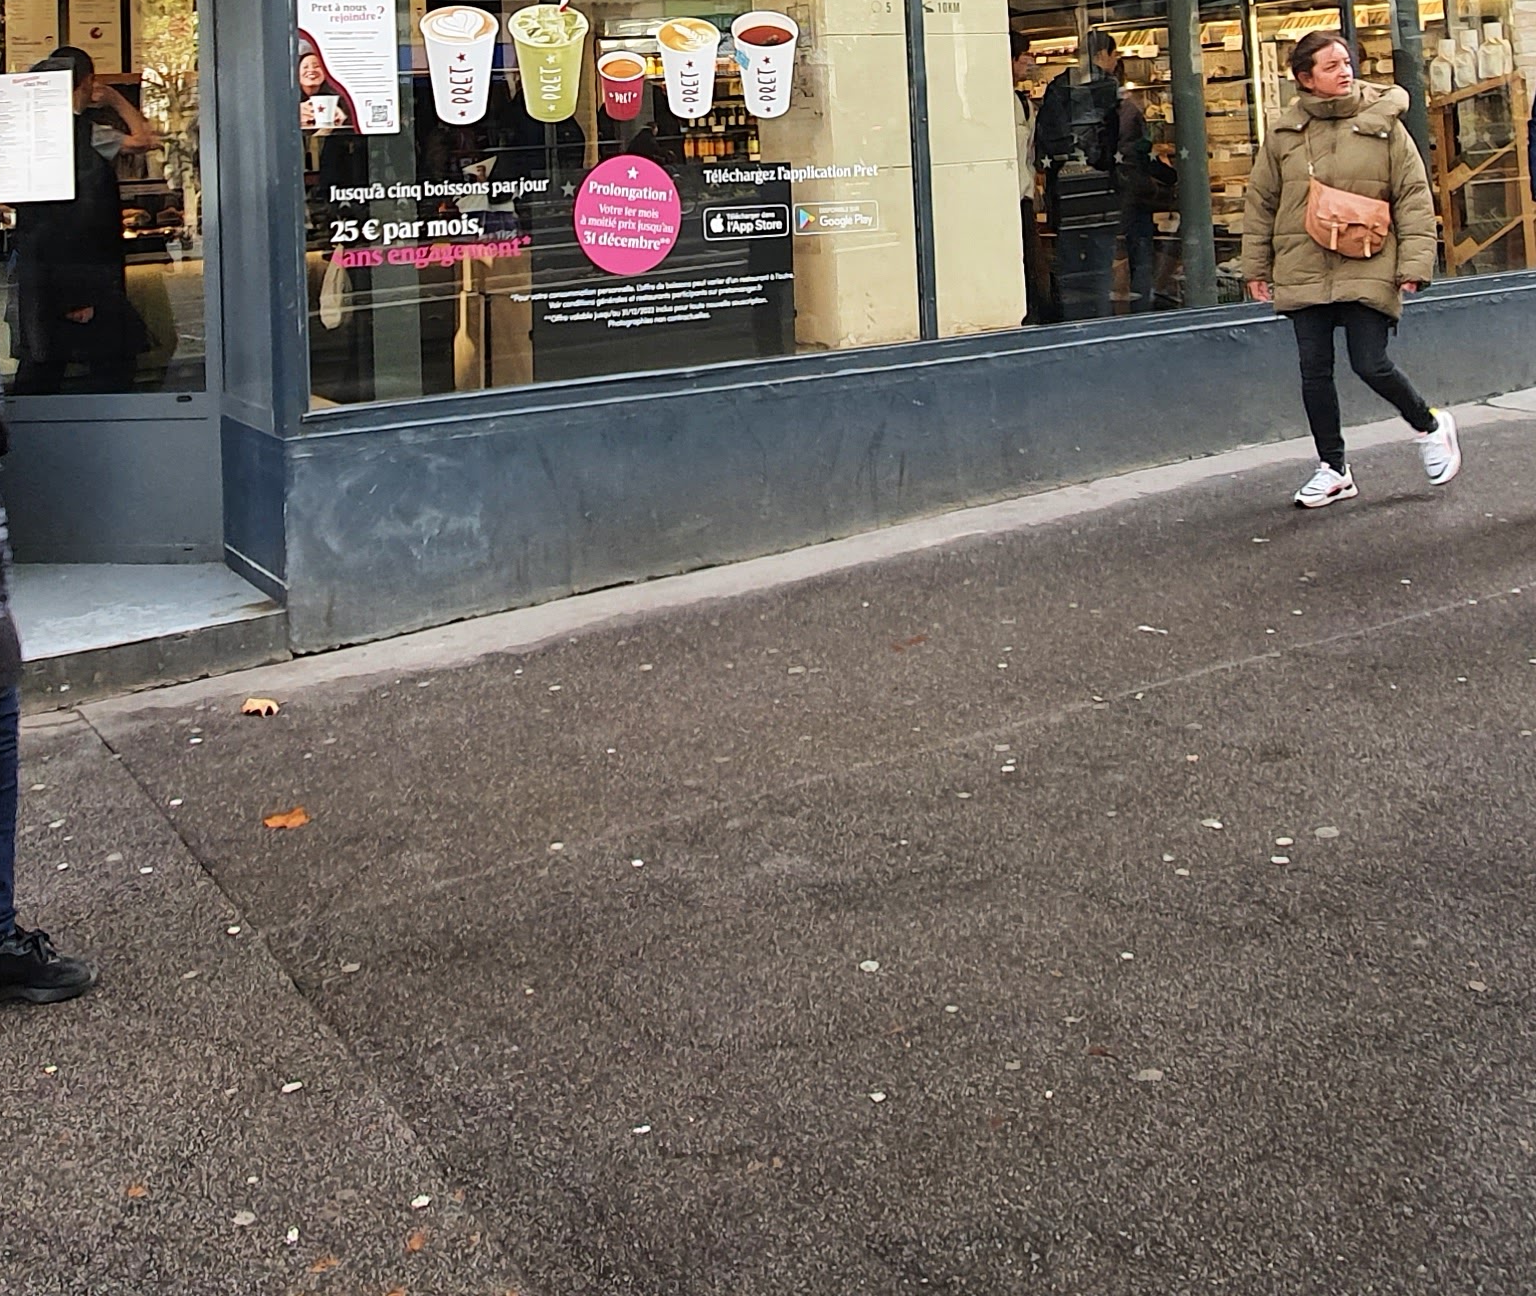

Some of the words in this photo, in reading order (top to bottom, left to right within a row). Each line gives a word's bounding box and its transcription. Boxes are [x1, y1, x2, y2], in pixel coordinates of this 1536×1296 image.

[450, 67, 474, 105] PRET
[540, 67, 560, 101] PRET
[682, 70, 700, 103] PRET
[759, 67, 777, 103] PRET
[703, 169, 776, 185] Téléchargez
[777, 165, 851, 183] l'application
[853, 164, 879, 177] Pret
[387, 181, 421, 201] cinq
[424, 179, 490, 197] boissons
[492, 180, 518, 198] par
[517, 176, 550, 196] jour
[588, 180, 667, 202] Prolongation
[598, 203, 623, 216] Votre
[637, 208, 659, 219] mois
[819, 215, 853, 229] Google
[854, 213, 873, 227] Play
[329, 220, 359, 243] 25
[362, 218, 381, 240] €
[383, 220, 426, 245] par
[427, 214, 485, 238] mois,
[580, 215, 586, 225] à
[587, 216, 617, 228] moitié
[617, 218, 636, 231] prix
[637, 219, 674, 235] jusqu'au
[727, 220, 754, 234] l'App
[755, 219, 783, 231] Store
[583, 230, 596, 245] 31
